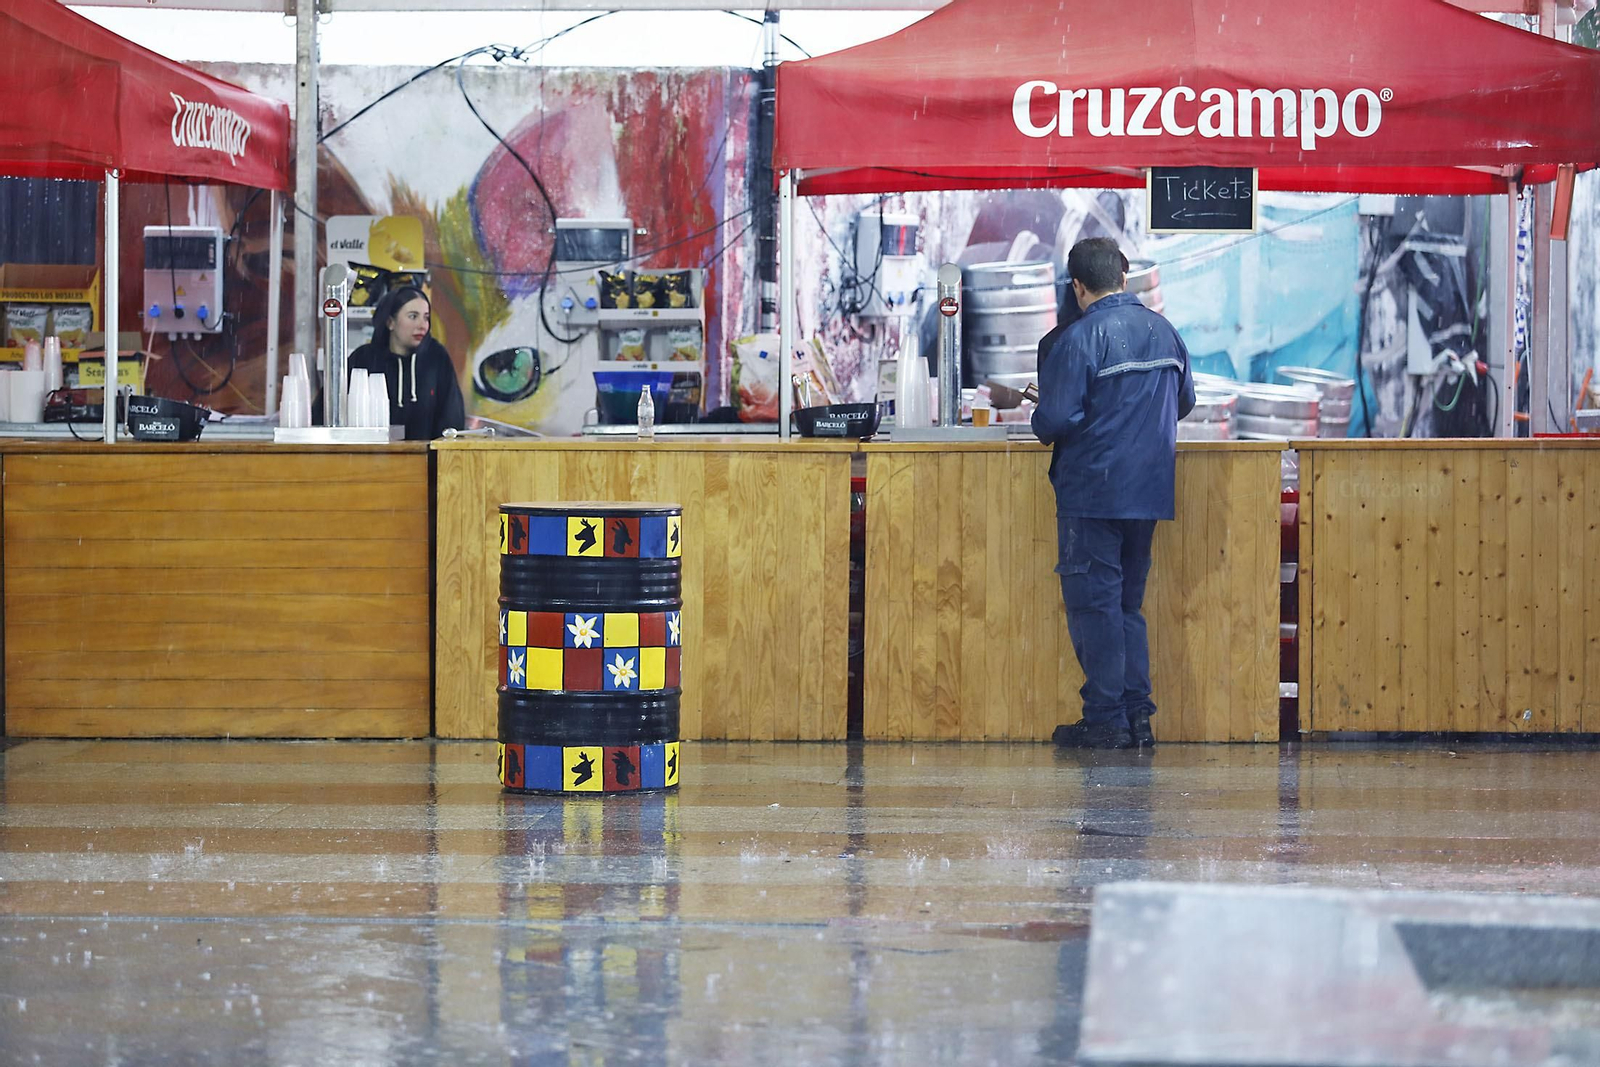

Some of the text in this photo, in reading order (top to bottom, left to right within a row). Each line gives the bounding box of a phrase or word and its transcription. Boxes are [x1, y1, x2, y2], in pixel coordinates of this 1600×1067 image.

[169, 91, 251, 167] Cruzcampo
[1155, 176, 1252, 201] Tickets
[340, 239, 364, 250] Valle
[139, 423, 175, 431] BARCELÓ
